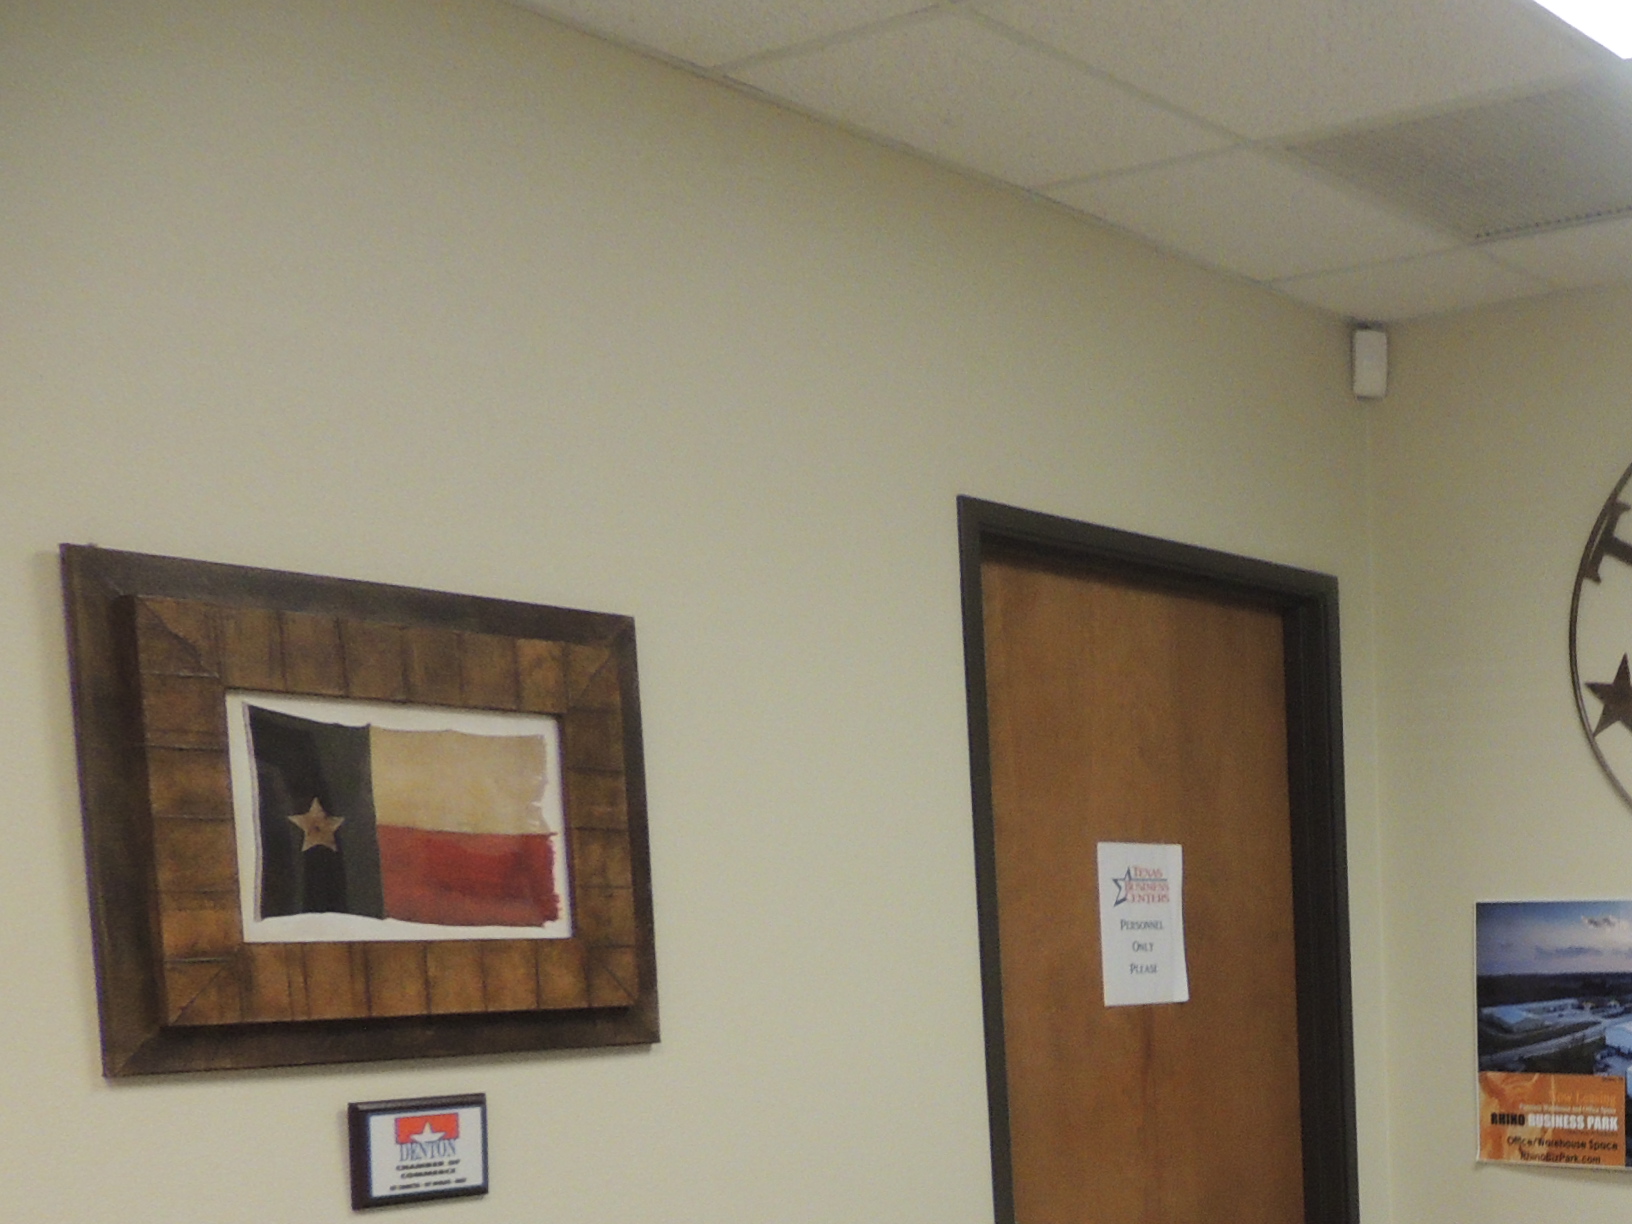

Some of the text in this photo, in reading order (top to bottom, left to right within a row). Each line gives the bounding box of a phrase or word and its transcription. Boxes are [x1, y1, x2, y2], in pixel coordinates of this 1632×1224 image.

[1132, 866, 1163, 878] TEXAS
[1125, 881, 1170, 892] BUSINESS
[1527, 1113, 1585, 1130] BUSINESS
[1587, 1115, 1619, 1132] PARK
[399, 1138, 457, 1162] DENTON
[1588, 1139, 1619, 1151] Space
